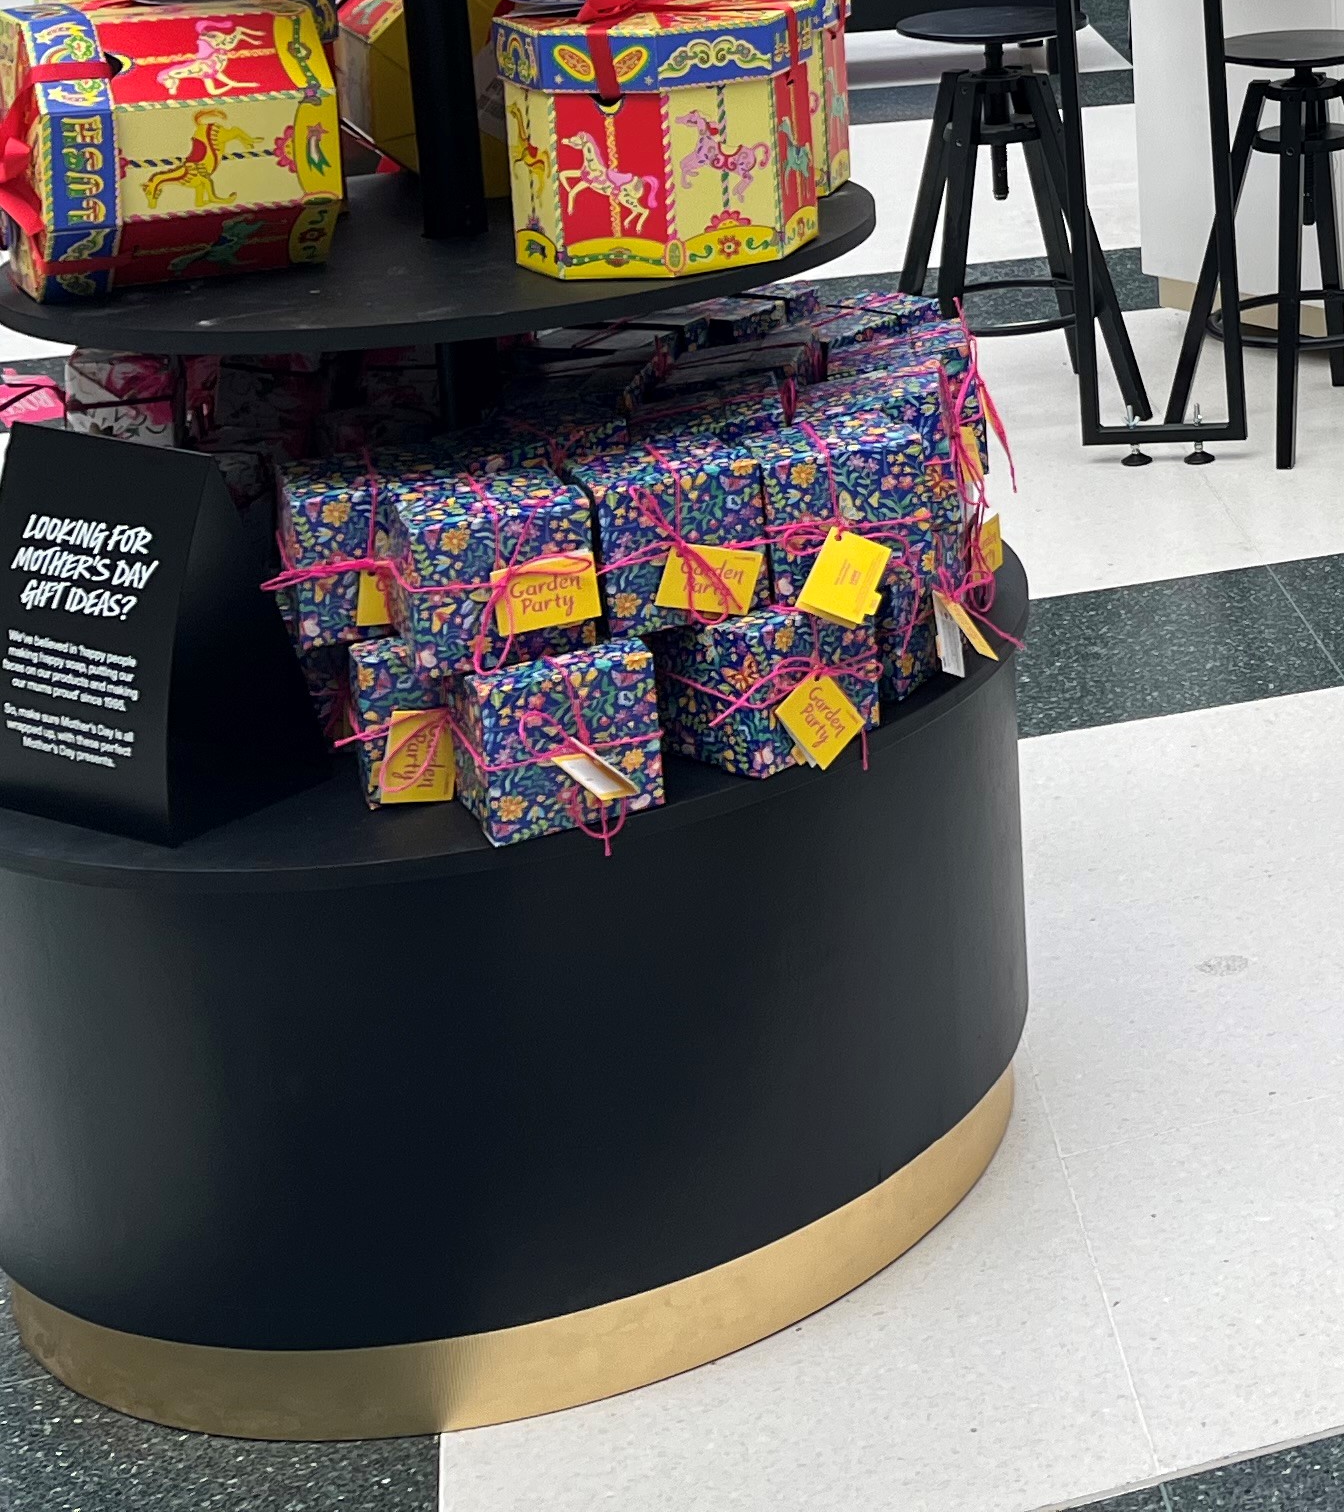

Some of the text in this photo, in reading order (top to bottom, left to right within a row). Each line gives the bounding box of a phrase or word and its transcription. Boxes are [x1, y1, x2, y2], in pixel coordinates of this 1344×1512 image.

[23, 513, 152, 554] LOOKING FOR
[11, 546, 159, 589] MOTHER'S DAY
[20, 579, 137, 620] GIFT IDEAS?
[510, 573, 582, 617] Garden Party
[799, 687, 846, 748] Garden Party
[392, 732, 429, 781] Party
